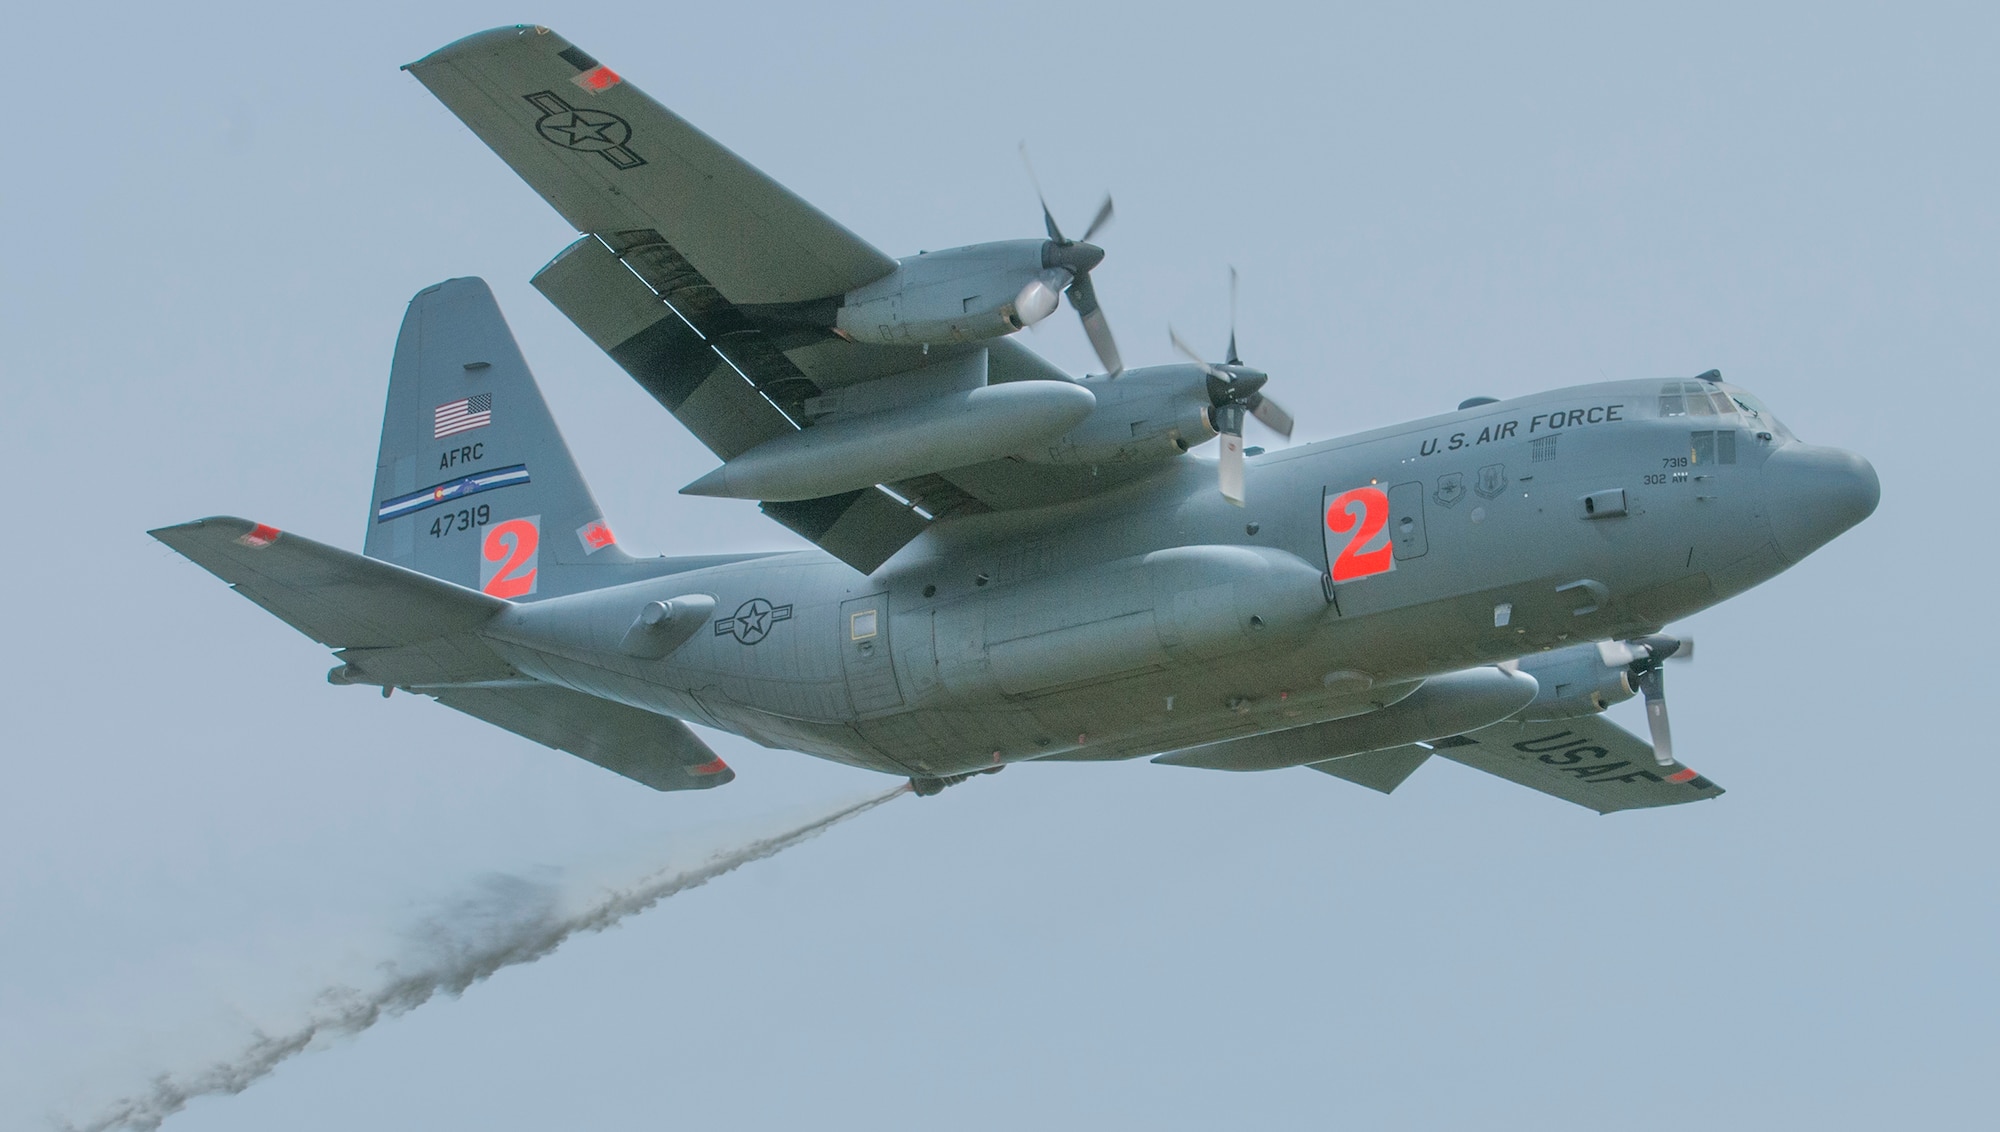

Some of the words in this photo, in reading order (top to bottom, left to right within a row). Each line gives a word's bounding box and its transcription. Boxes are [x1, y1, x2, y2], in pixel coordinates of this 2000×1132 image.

[1476, 420, 1518, 445] AIR
[1530, 405, 1624, 433] FORCE
[439, 442, 484, 470] AFRC
[1662, 457, 1688, 469] 7319
[1643, 473, 1667, 486] 302
[429, 504, 491, 538] 47319
[1326, 487, 1393, 582] 2
[483, 519, 539, 599] 2
[1512, 730, 1665, 784] USAF
